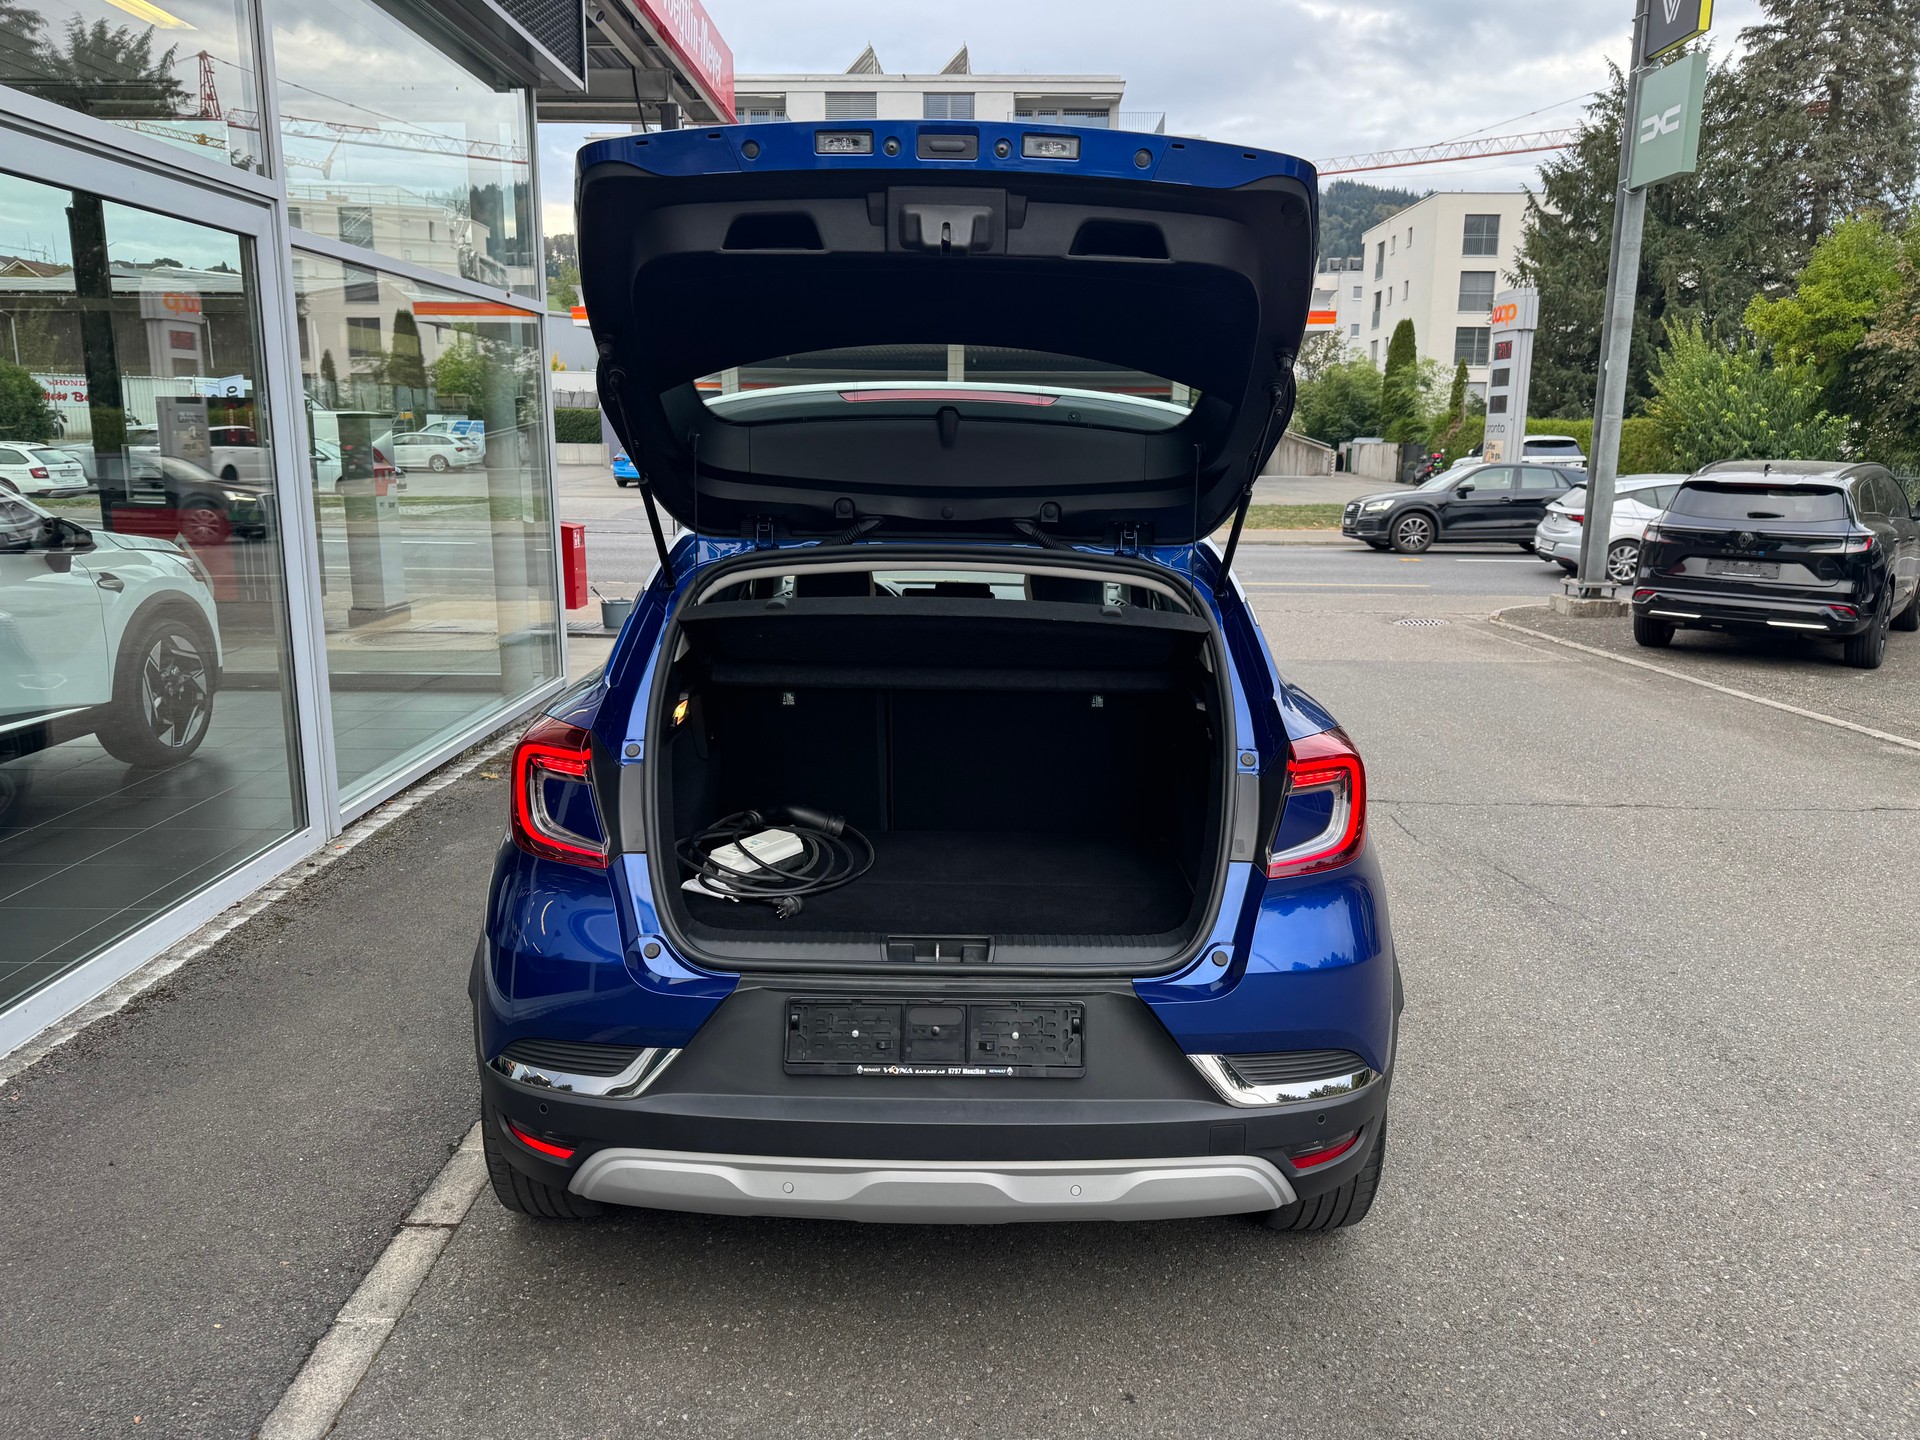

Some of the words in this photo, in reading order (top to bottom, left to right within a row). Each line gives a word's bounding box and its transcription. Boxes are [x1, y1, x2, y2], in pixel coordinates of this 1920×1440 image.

[663, 0, 722, 87] oegtlin-Meyer
[54, 379, 87, 387] HOND
[1720, 548, 1765, 556] ESPACE
